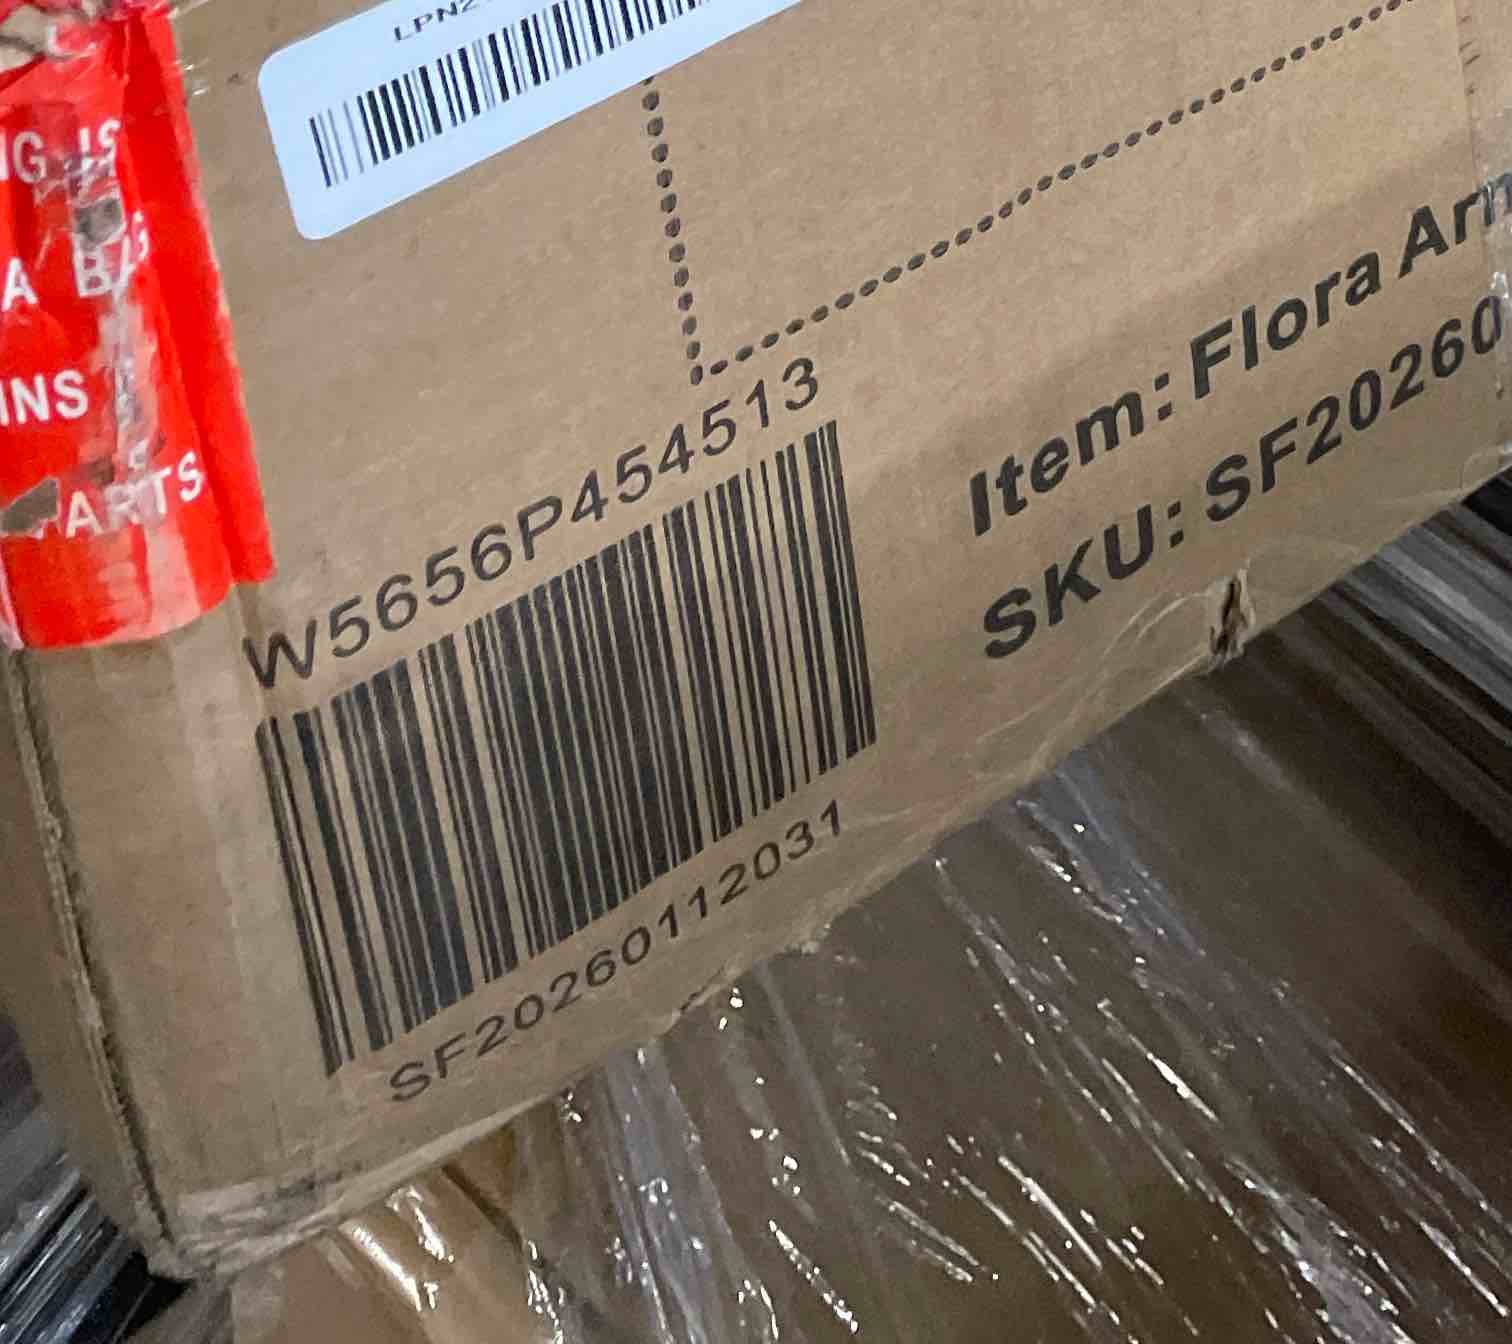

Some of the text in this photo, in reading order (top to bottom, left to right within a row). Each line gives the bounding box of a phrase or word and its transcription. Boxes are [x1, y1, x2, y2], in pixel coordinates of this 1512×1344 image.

[36, 449, 204, 540] ARTS
[243, 355, 821, 692] W5656P454513
[968, 371, 1173, 537] Item:
[1190, 251, 1383, 399] Flora
[982, 500, 1185, 659] SKU:
[388, 798, 844, 1103] SF20260112031
